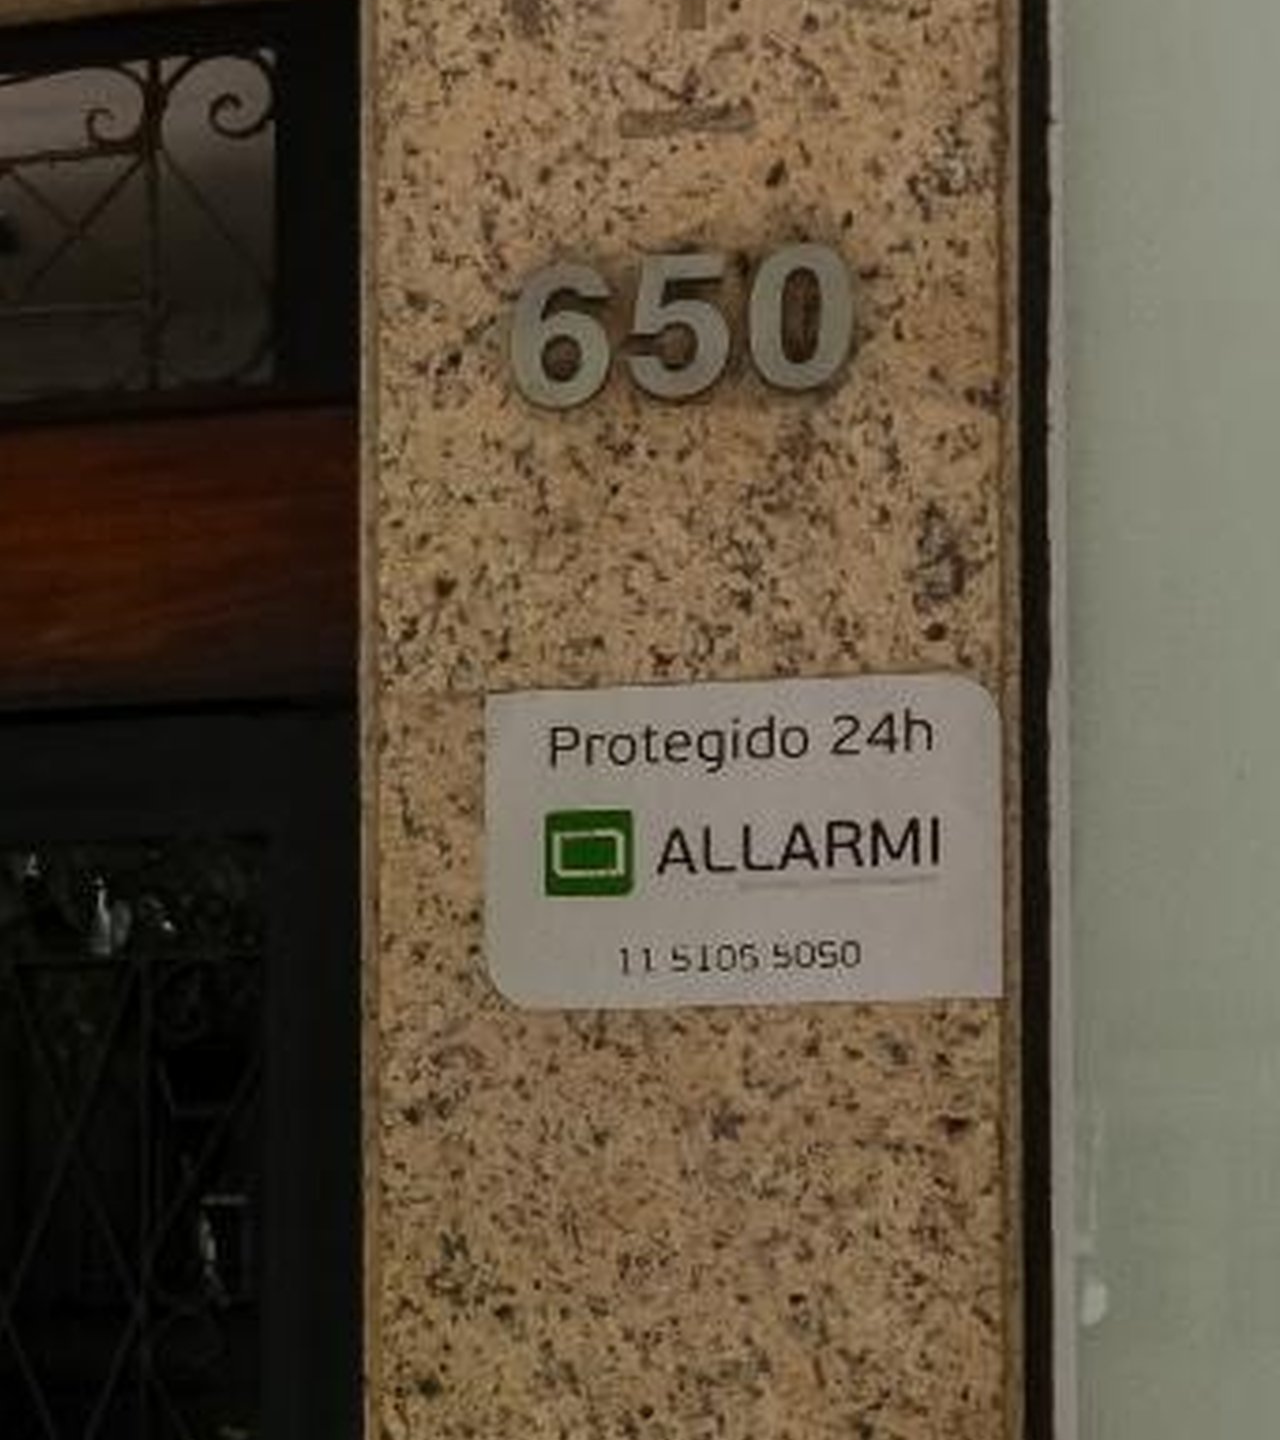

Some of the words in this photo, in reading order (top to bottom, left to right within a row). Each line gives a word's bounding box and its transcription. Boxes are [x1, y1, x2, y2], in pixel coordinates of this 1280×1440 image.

[510, 243, 857, 410] 650
[550, 716, 809, 773] Protegido
[830, 708, 933, 756] 24h
[657, 816, 939, 875] ALLARMI
[619, 947, 653, 975] 11
[773, 939, 861, 969] 5050
